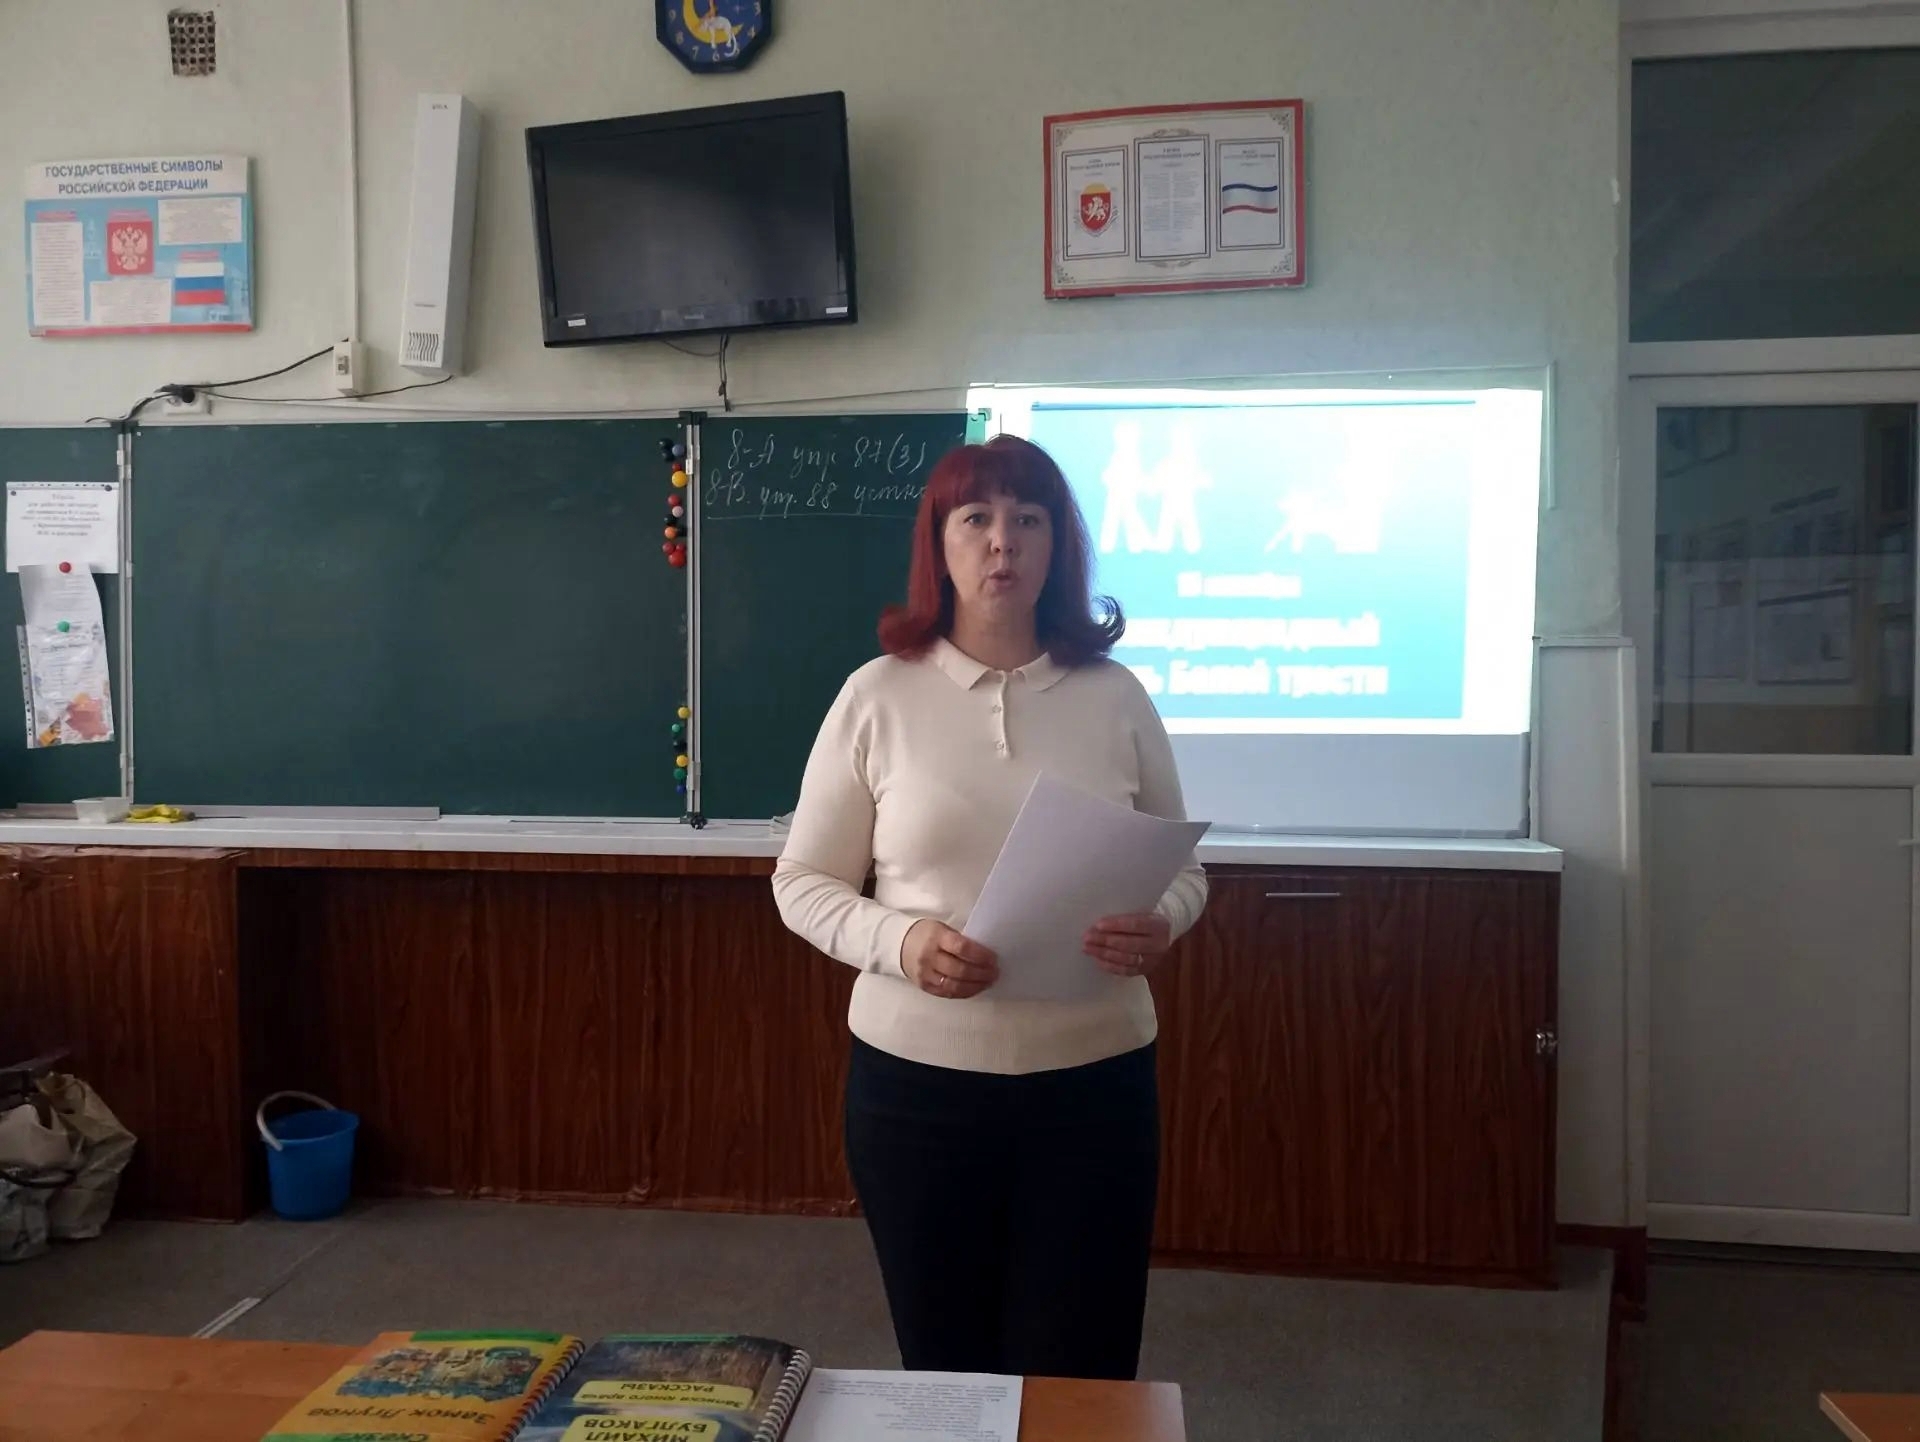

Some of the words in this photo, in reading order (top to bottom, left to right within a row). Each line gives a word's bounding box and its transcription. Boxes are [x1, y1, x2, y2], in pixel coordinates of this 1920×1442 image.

[45, 160, 159, 178] ГОСУДАРСТВЕННЫЕ
[160, 159, 224, 173] СИМВОЛЫ
[58, 178, 136, 195] РОССИЙСКОЙ
[138, 178, 209, 193] ФЕДЕРАЦИИ
[806, 481, 838, 509] 88
[620, 1382, 716, 1394] РАССКАЗЫ
[584, 1418, 708, 1434] БУЛГАКОВ
[585, 1431, 690, 1442] МИХАИЛ
